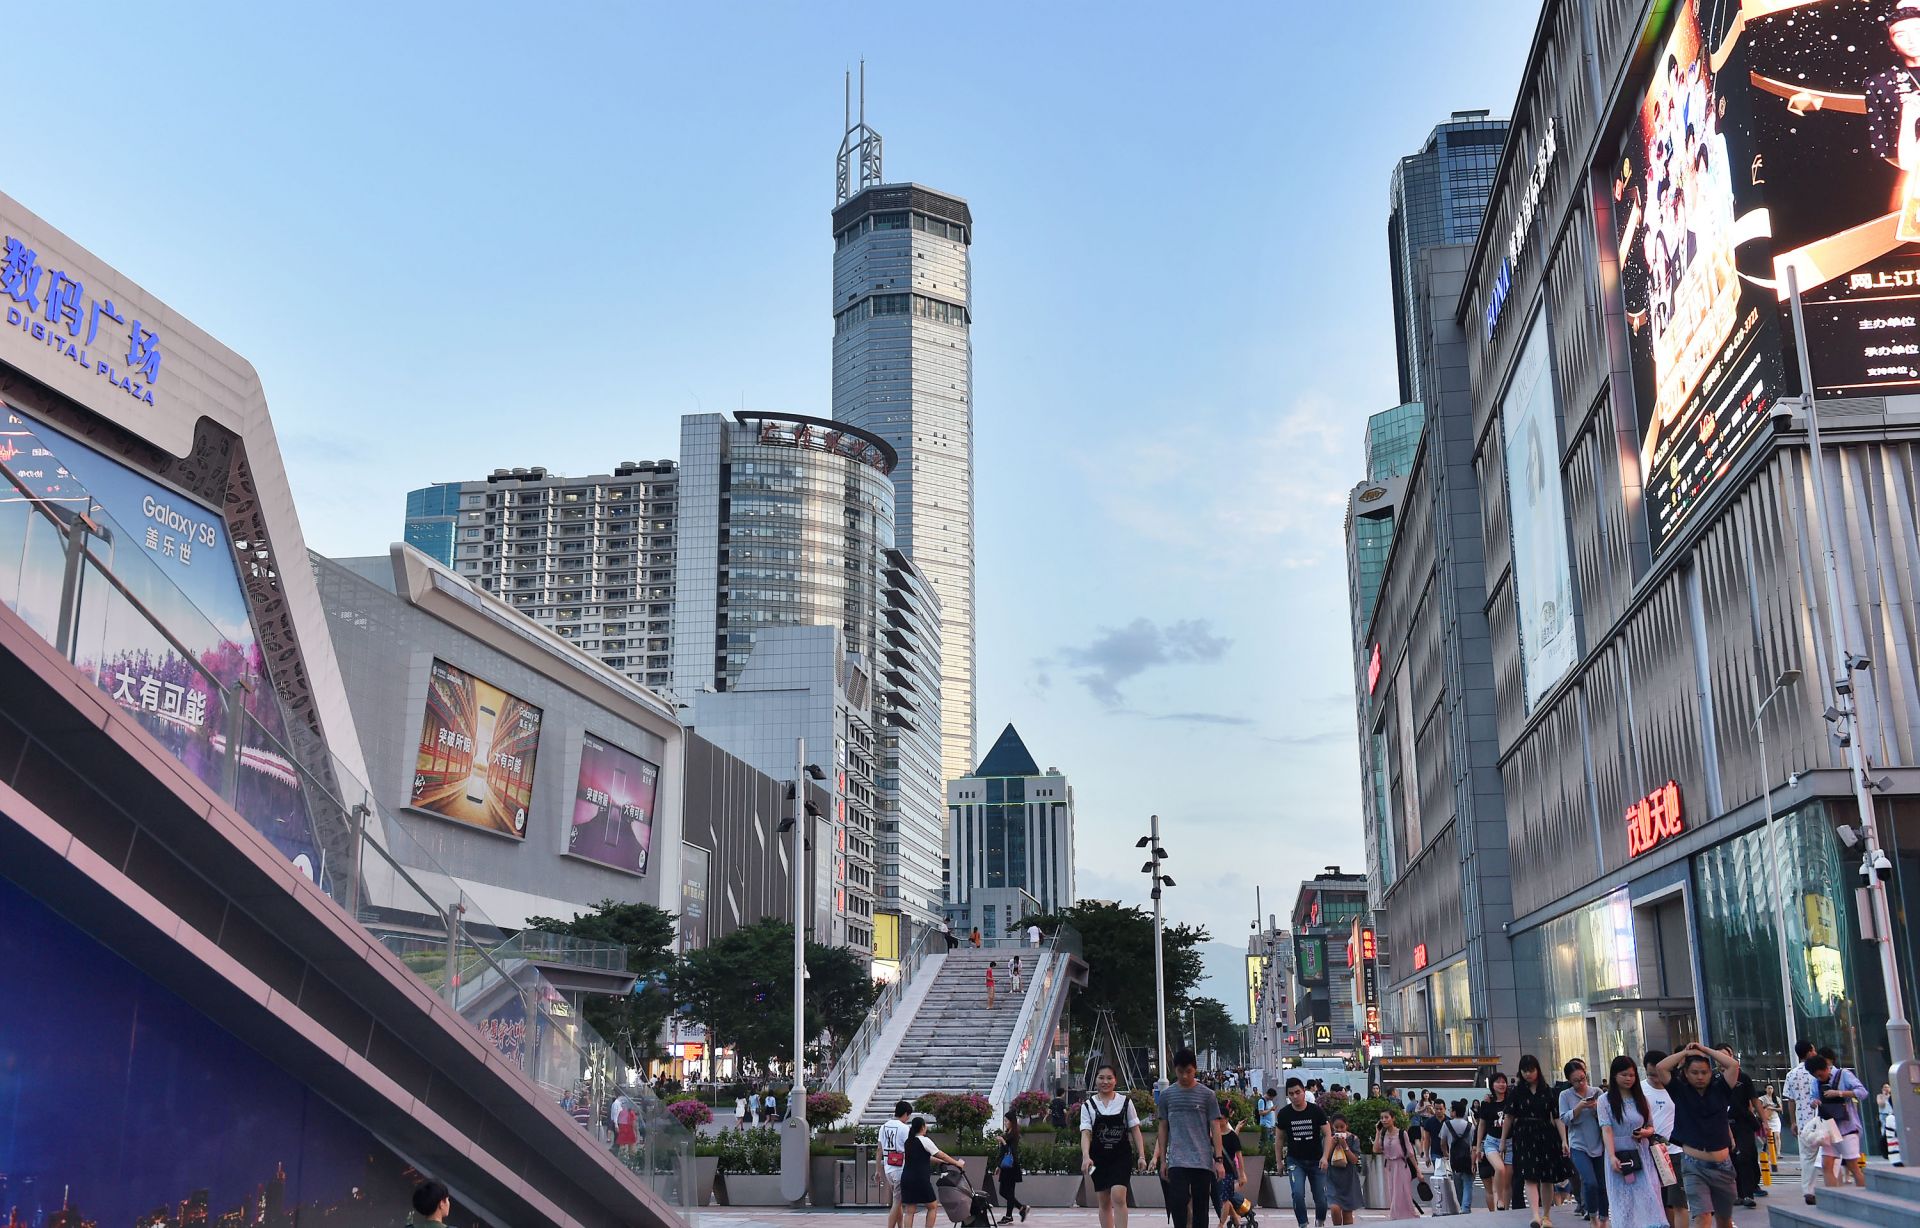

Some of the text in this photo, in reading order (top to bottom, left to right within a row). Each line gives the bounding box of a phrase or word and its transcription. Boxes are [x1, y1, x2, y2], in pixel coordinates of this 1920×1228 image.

[0, 235, 162, 386] 数码广场
[1486, 256, 1510, 341] BONA
[1858, 315, 1917, 330] 主办单位
[7, 305, 155, 407] DIGITAL PLAZA
[1864, 344, 1920, 358] 承办单位
[142, 494, 217, 548] Galaxy S8
[144, 526, 193, 567] 盖乐世
[112, 666, 208, 727] 大有可能
[438, 727, 473, 754] 突破所限
[492, 751, 523, 774] 大有可能
[623, 803, 645, 822] 大有可能
[1625, 779, 1684, 858] 茂业天地
